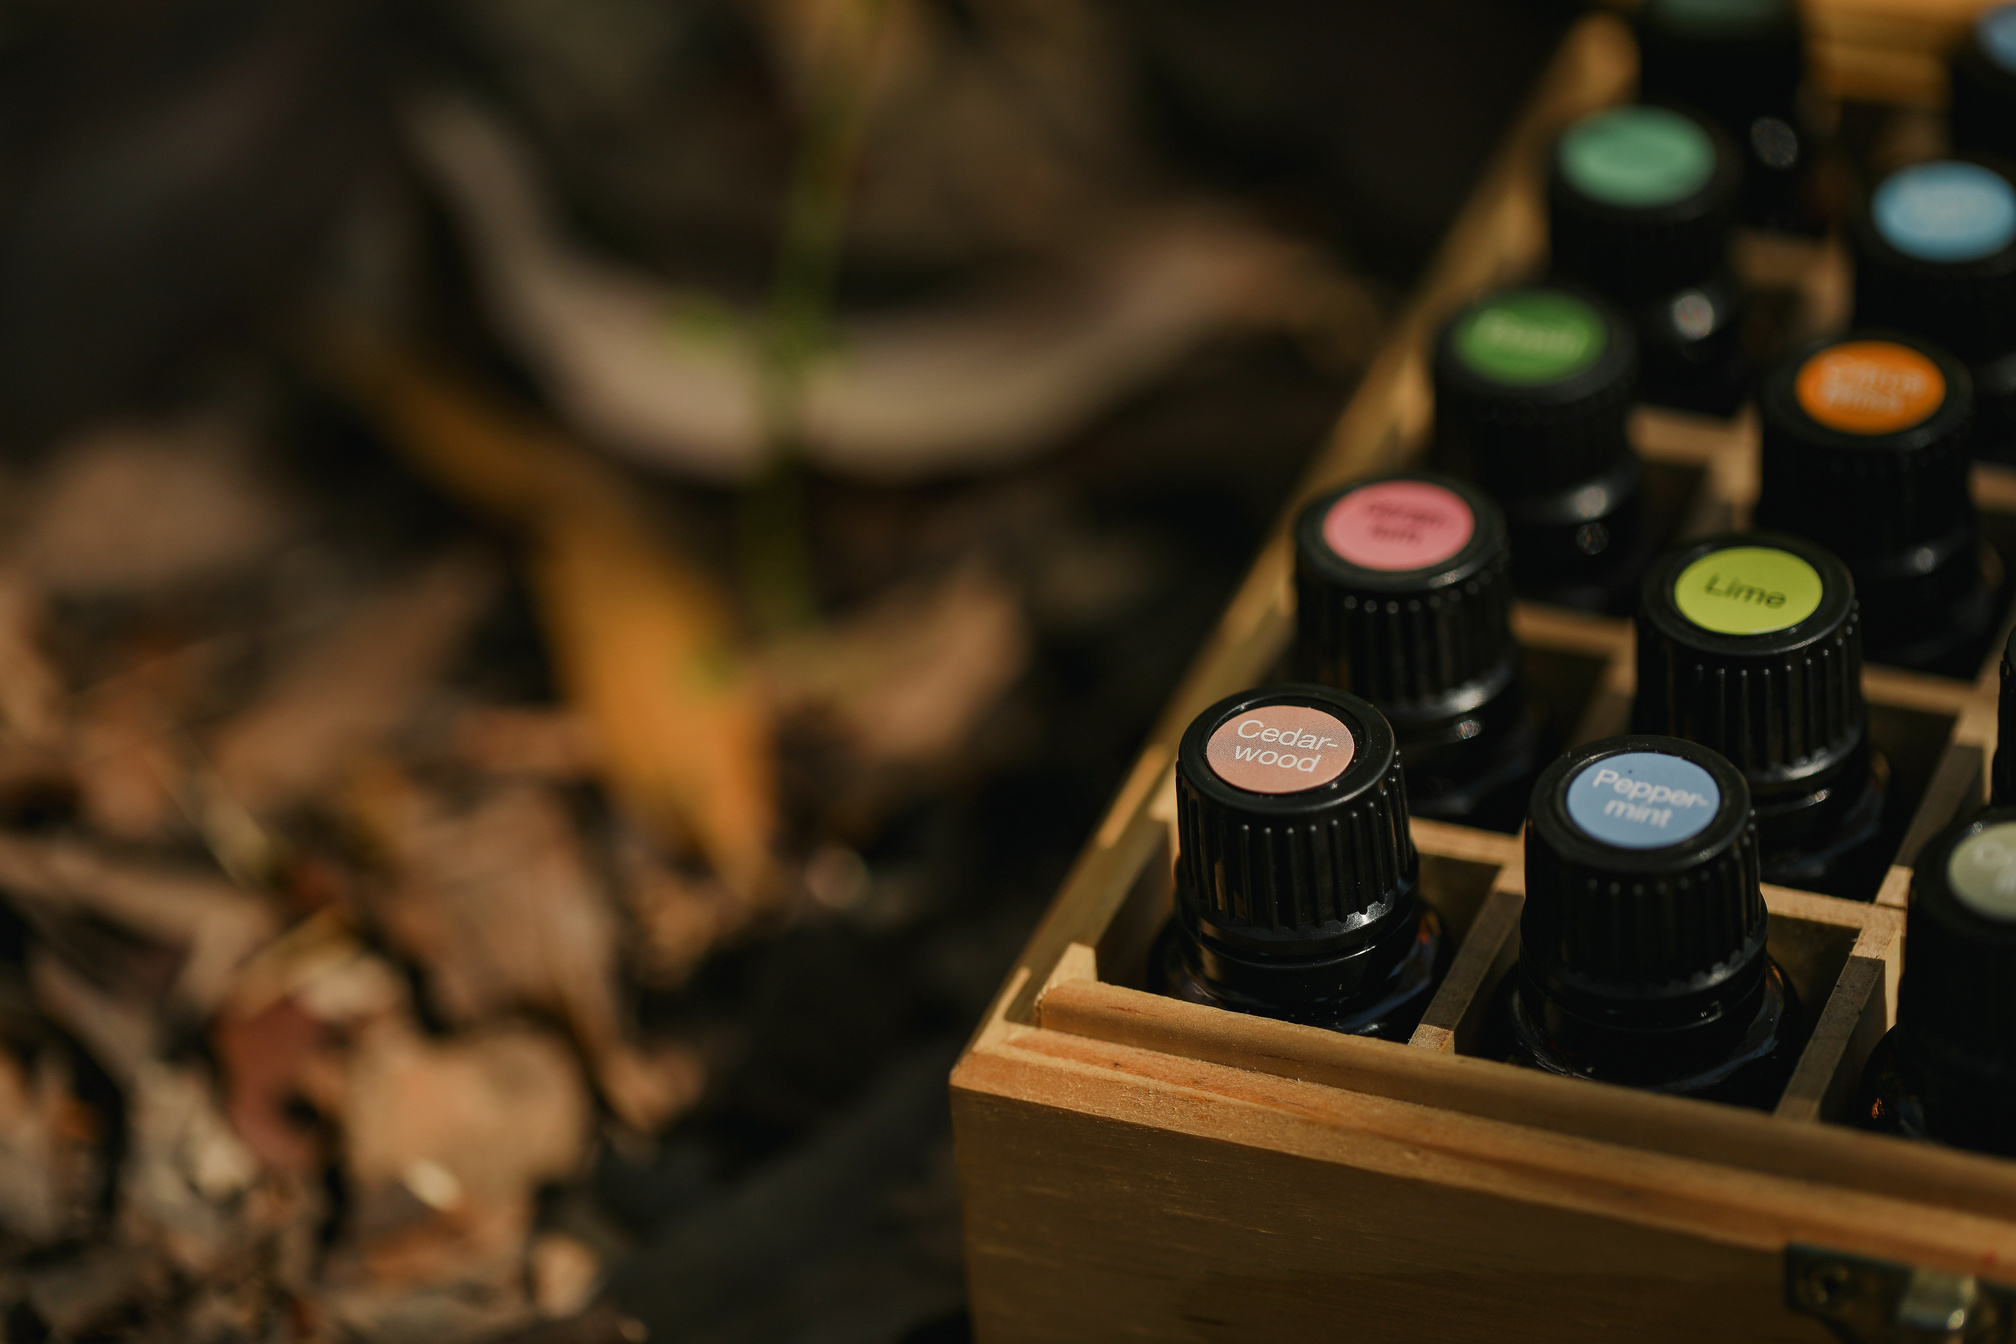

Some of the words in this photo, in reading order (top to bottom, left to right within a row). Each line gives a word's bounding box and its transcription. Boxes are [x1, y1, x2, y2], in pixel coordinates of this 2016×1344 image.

[1704, 572, 1787, 610] Lime
[1237, 719, 1338, 750] Cedar-
[1234, 745, 1322, 773] wood
[1592, 769, 1709, 809] Pepper-
[1604, 799, 1673, 829] mint
